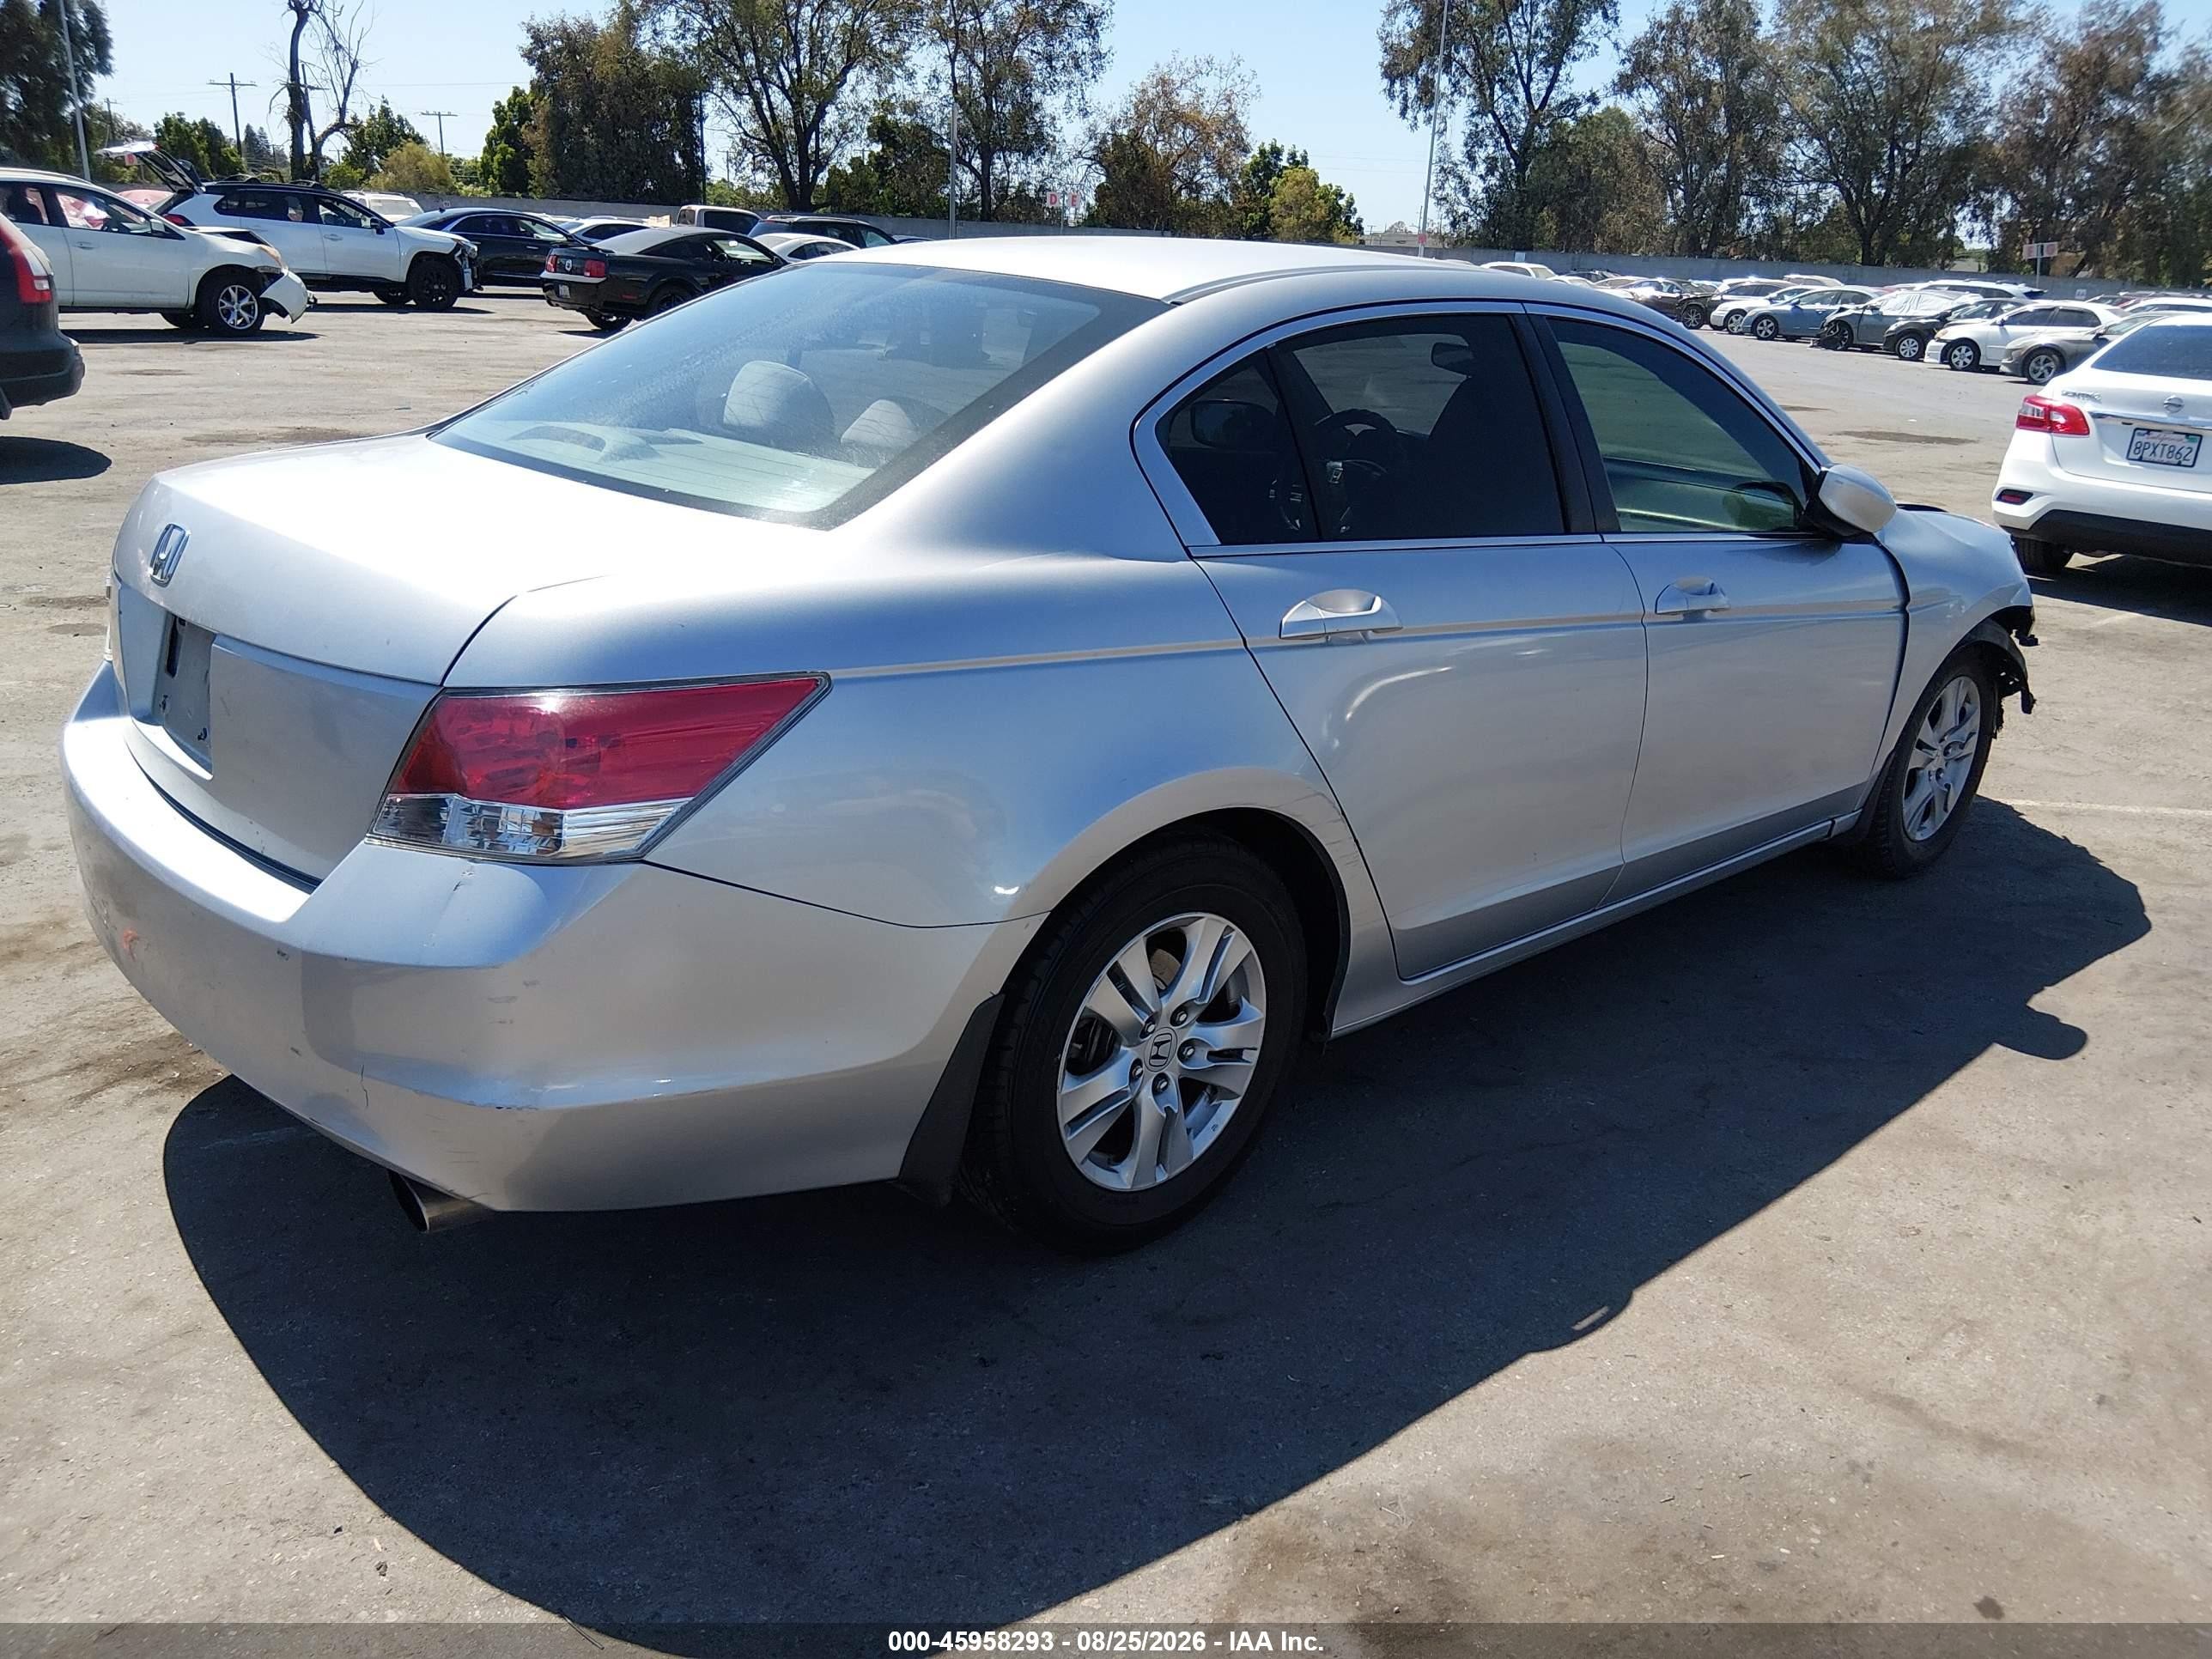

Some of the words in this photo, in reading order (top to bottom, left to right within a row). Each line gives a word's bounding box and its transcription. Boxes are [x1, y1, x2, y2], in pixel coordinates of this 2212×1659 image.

[1049, 193, 1058, 205] D
[1071, 194, 1078, 207] E
[2133, 441, 2193, 462] 8PXT862
